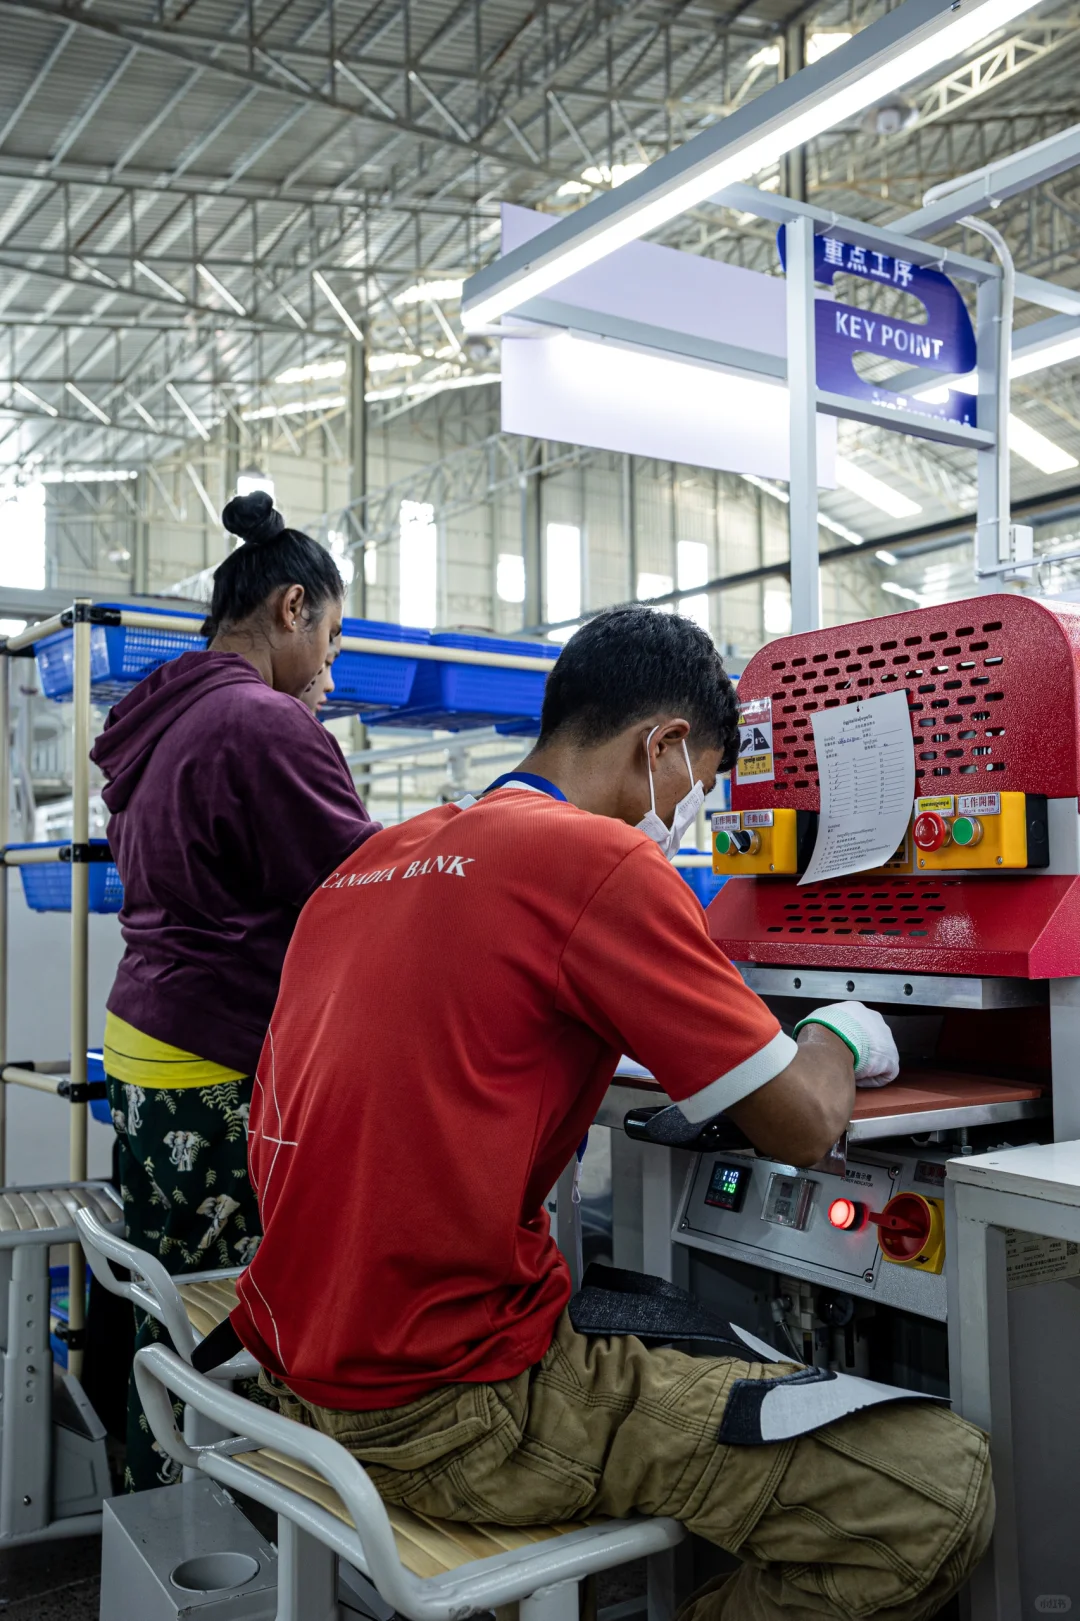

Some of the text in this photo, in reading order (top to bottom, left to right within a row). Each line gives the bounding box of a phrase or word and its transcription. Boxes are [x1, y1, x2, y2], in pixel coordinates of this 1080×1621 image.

[822, 237, 914, 287] 重点工序
[835, 311, 944, 361] KEY POINT
[321, 855, 476, 889] CANADIA BANK
